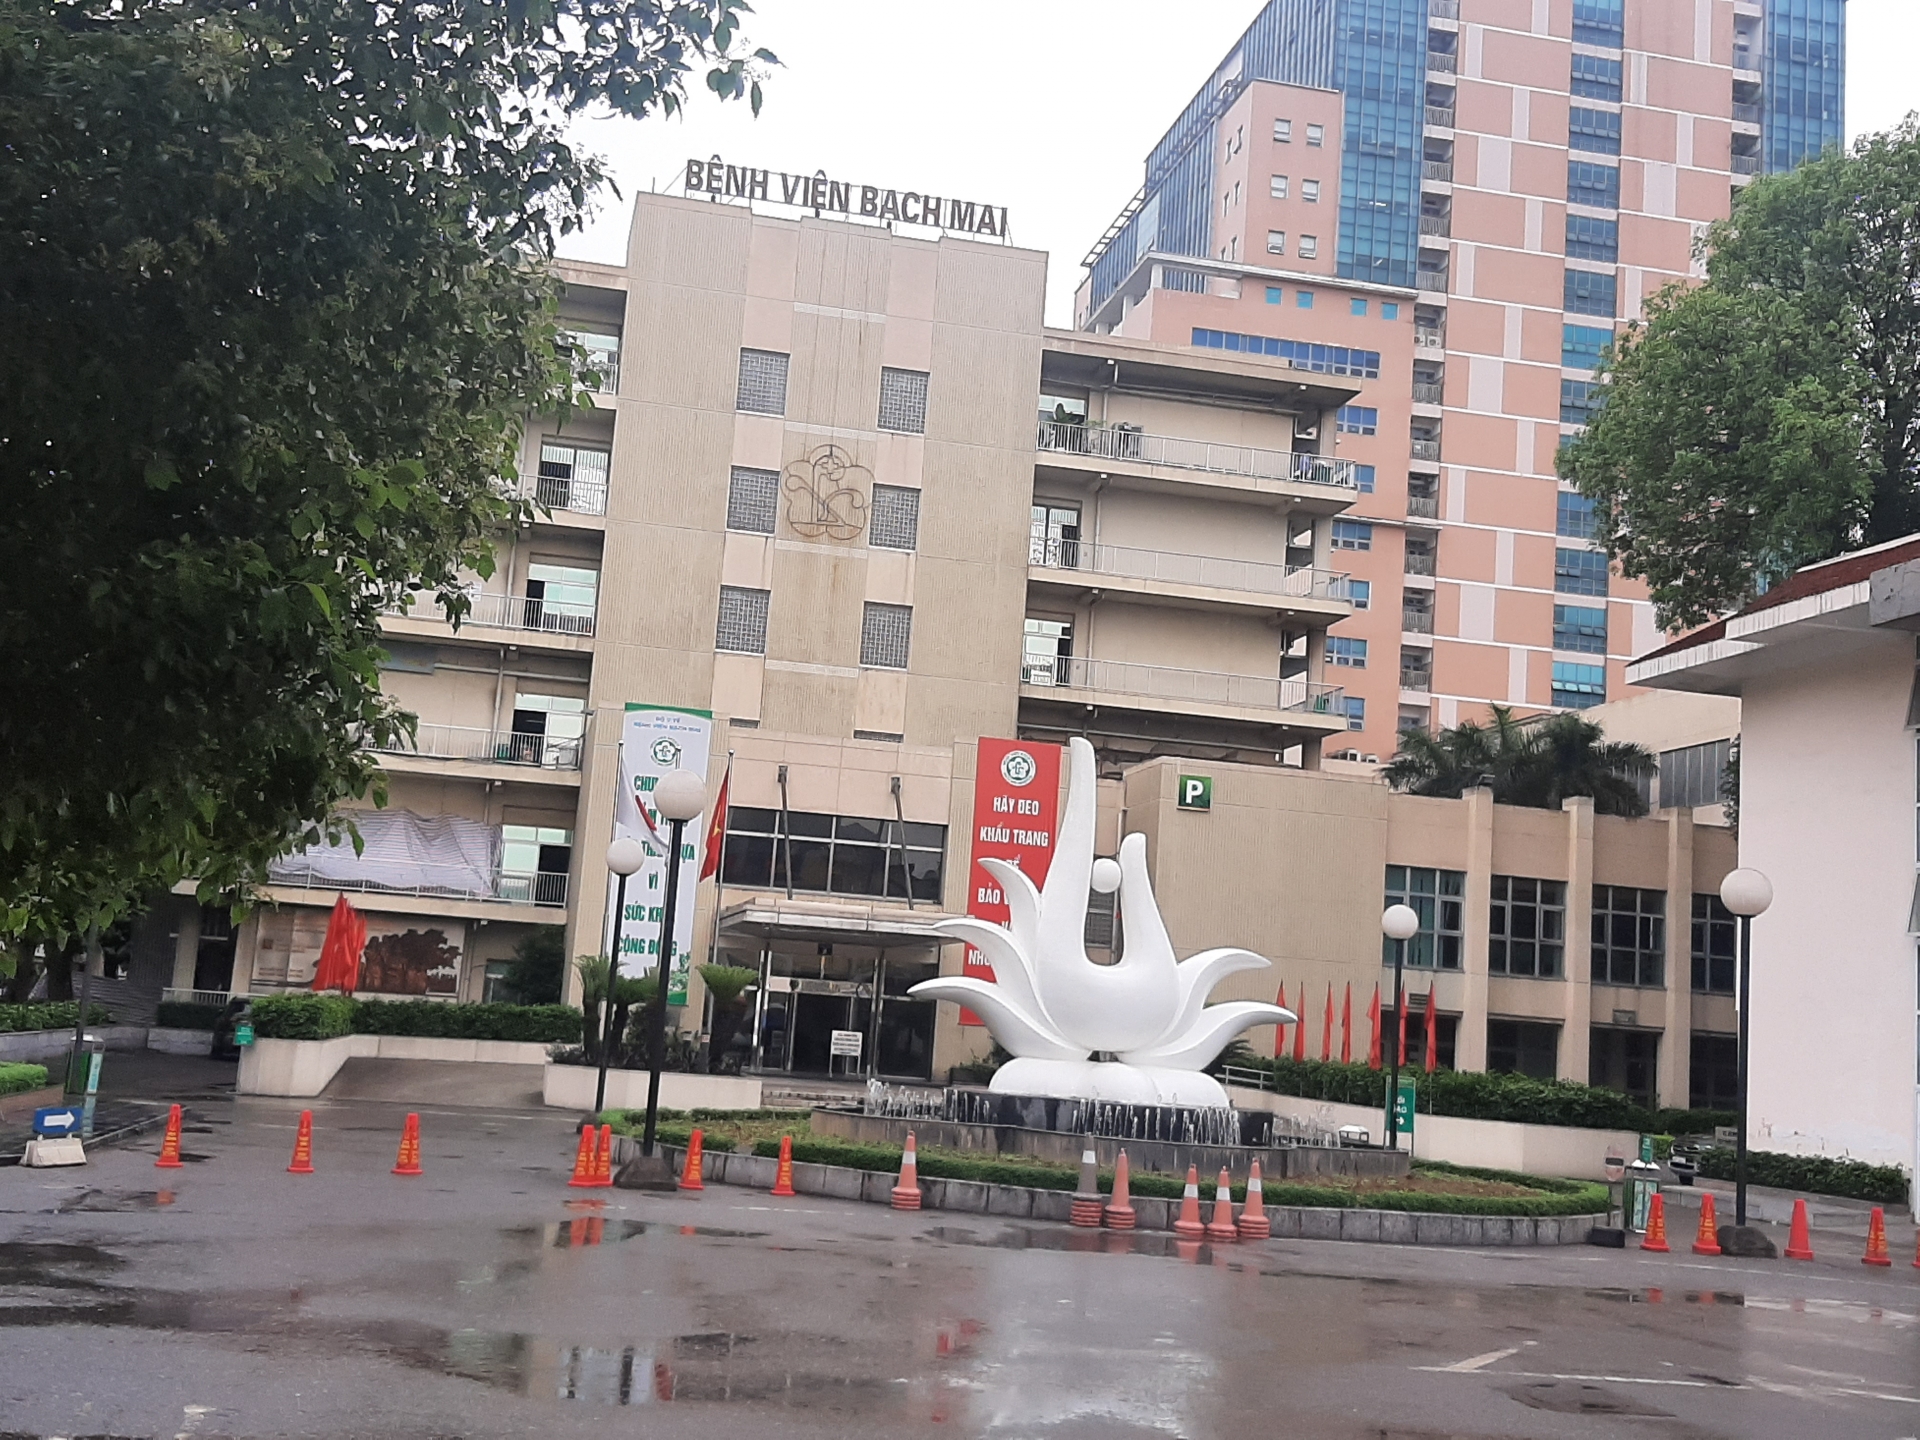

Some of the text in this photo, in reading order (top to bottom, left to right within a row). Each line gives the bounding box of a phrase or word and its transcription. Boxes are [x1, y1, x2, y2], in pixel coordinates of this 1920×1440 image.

[951, 199, 1008, 237] MAI
[1186, 779, 1204, 804] P
[993, 795, 1039, 815] HÃY ĐEO
[1013, 829, 1049, 847] TRANG
[649, 871, 658, 889] VÌ
[978, 882, 1000, 904] BẢO
[624, 900, 646, 921] SỨC
